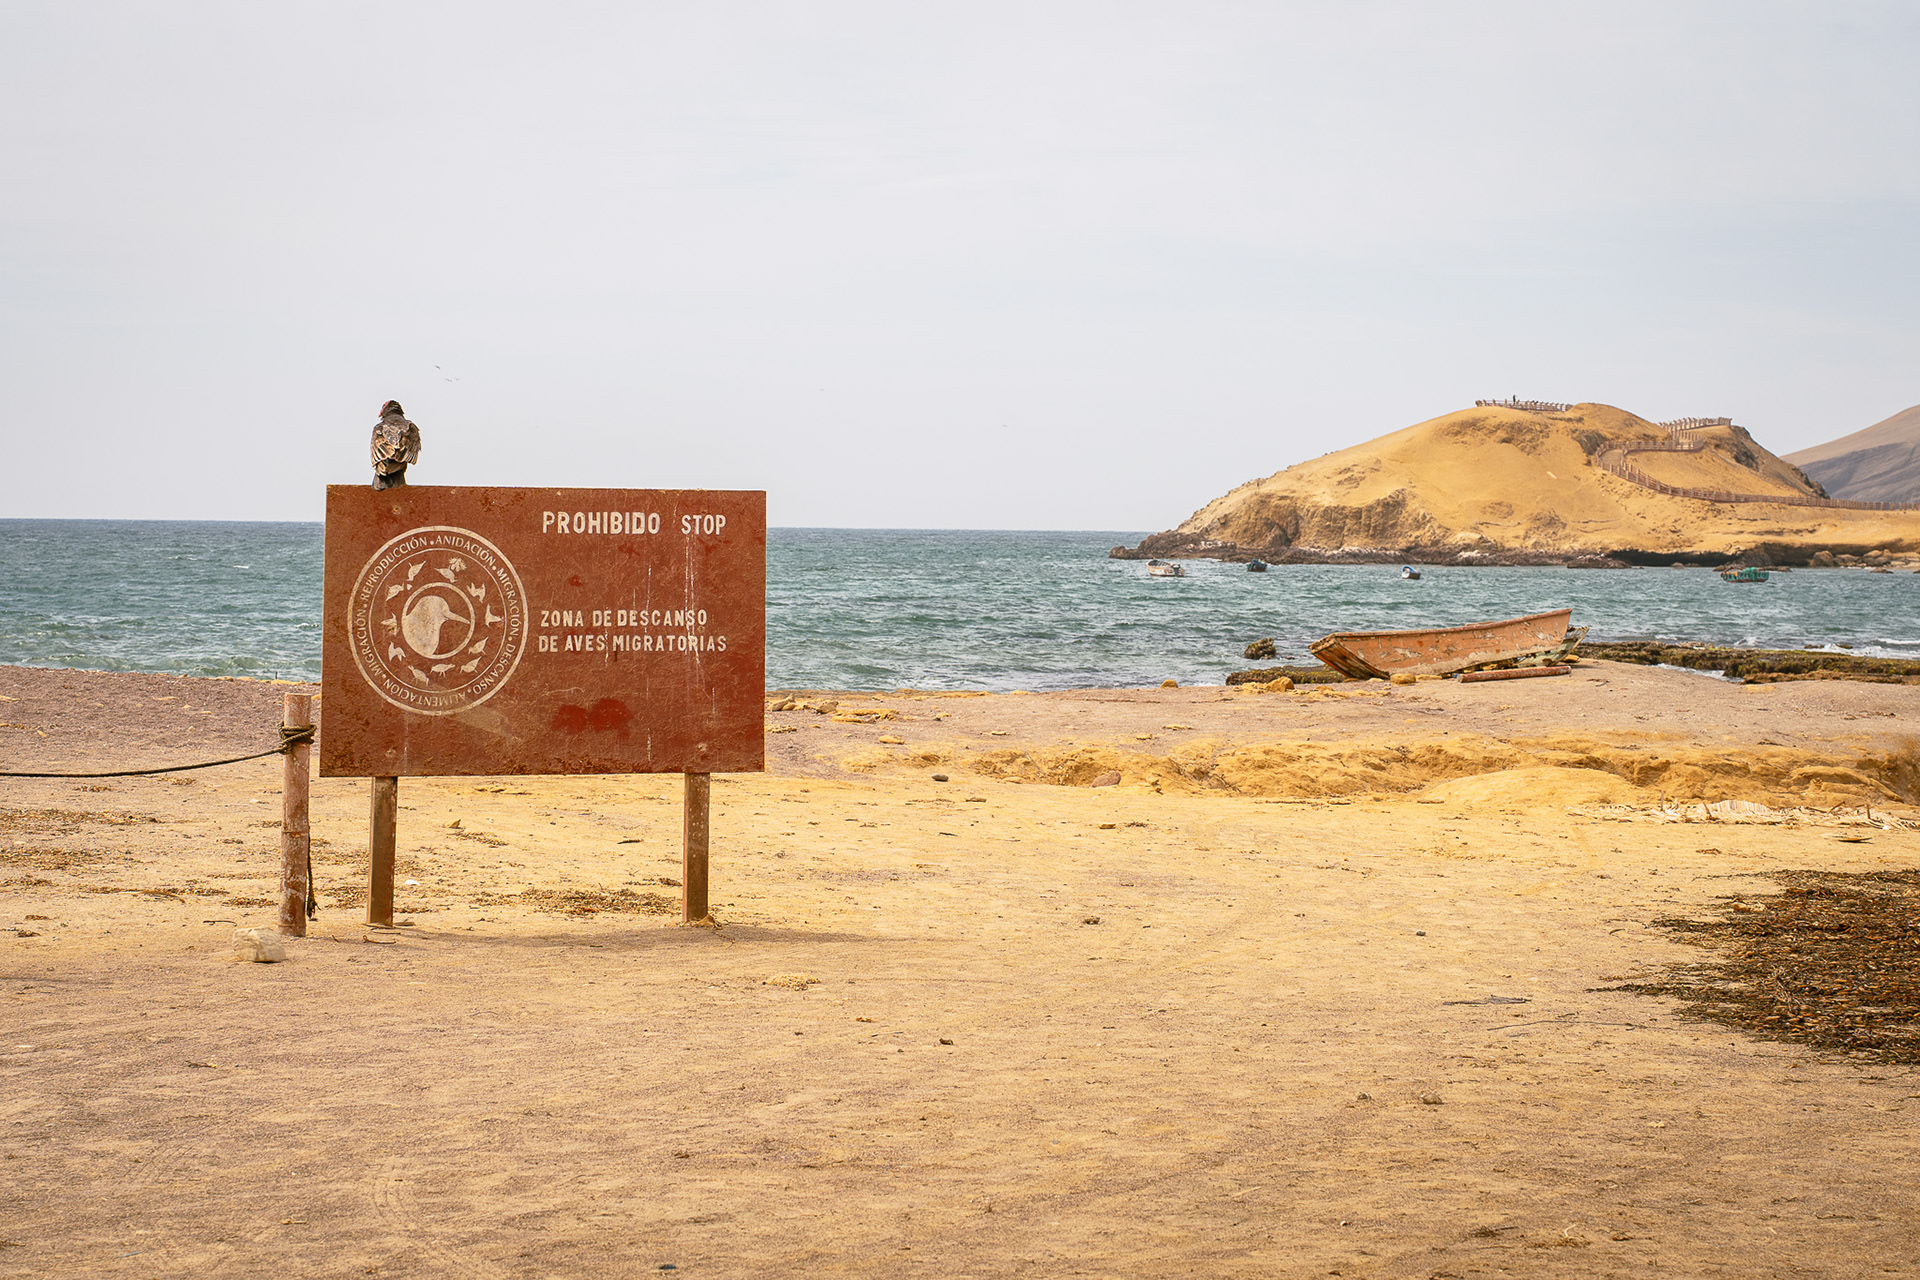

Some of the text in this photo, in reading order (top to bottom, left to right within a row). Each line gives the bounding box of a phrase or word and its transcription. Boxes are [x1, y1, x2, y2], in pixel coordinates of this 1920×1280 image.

[542, 511, 727, 535] PROHIBIDO STOP
[361, 536, 428, 602] REPRODUCCIÓN
[435, 534, 496, 566] ANIDACIÓN
[496, 568, 523, 637] MIGRACIÓN
[540, 609, 708, 627] ZONA DE DESCANSO
[354, 608, 384, 677] MIGRACIÓN
[538, 634, 727, 652] DE AVES MIGRATORIAS
[472, 643, 516, 696] DESCANSO
